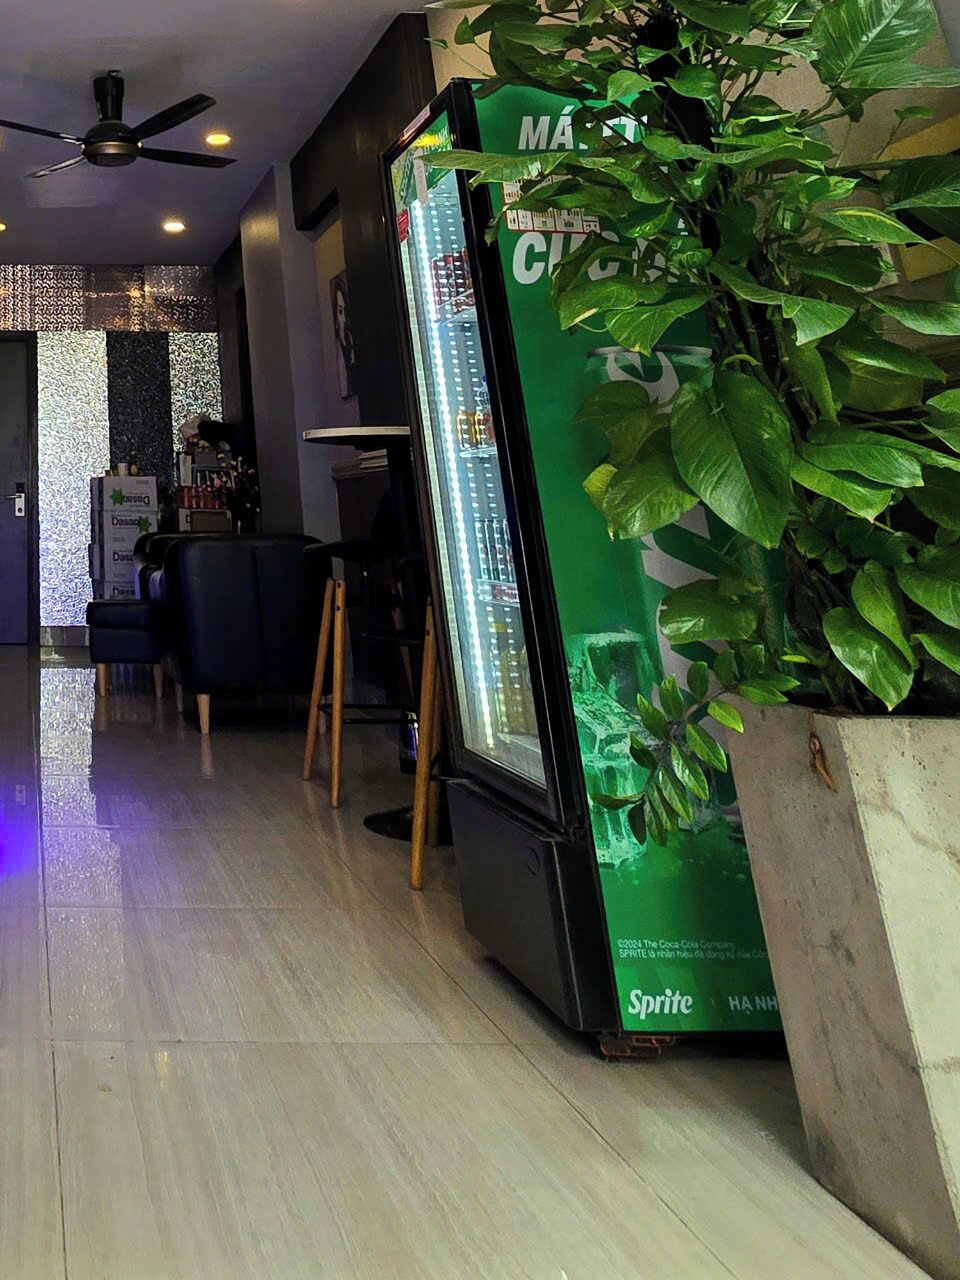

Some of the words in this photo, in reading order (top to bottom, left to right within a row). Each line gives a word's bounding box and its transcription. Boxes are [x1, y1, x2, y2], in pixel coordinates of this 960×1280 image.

[643, 939, 658, 949] The
[658, 939, 699, 949] Coca-Cola
[619, 948, 647, 959] SPRITE
[628, 988, 693, 1020] Sprite
[728, 995, 753, 1015] HẠ
